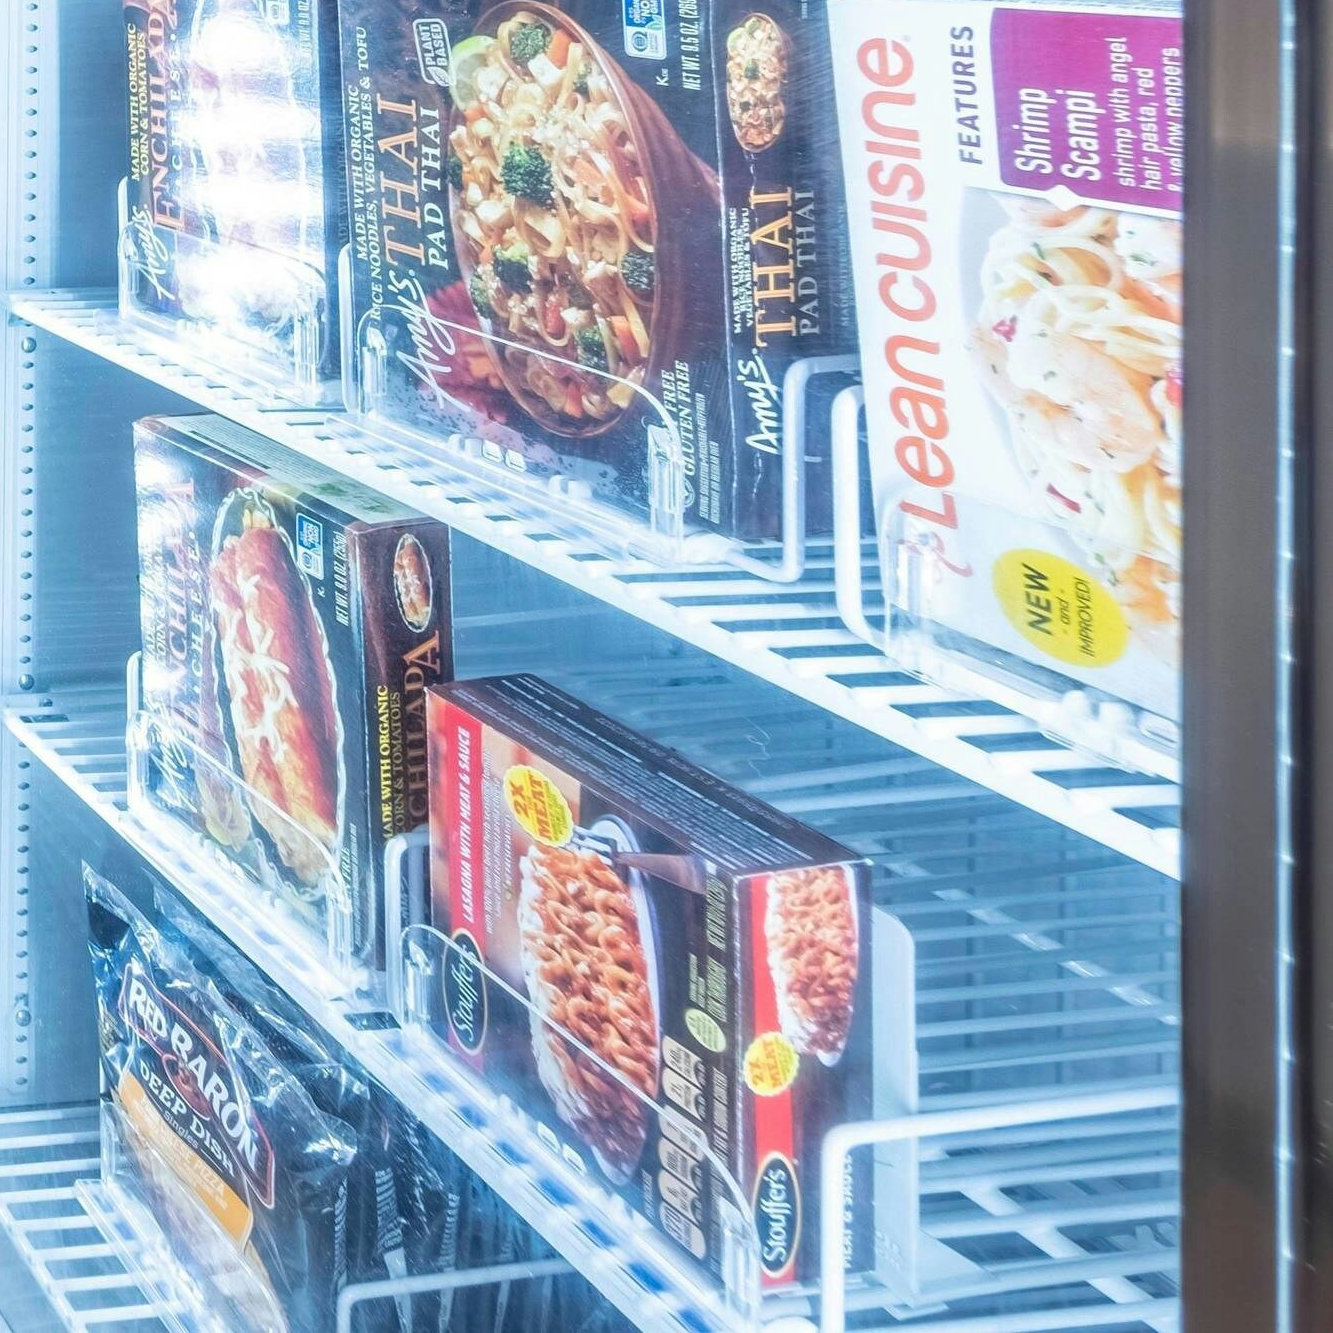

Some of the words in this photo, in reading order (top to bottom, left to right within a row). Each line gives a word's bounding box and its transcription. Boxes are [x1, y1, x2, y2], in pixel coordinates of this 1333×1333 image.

[356, 26, 369, 71] TOFU
[418, 24, 436, 66] PLANT
[430, 23, 448, 67] BASED
[679, 21, 699, 36] OZ.
[127, 22, 138, 91] ORGANIC
[137, 31, 148, 115] TOMATOES
[359, 76, 371, 90] &
[681, 54, 701, 71] WT.
[683, 71, 701, 90] NET
[1104, 37, 1133, 85] angel
[1132, 67, 1155, 98] red
[129, 95, 139, 139] WITH
[950, 25, 984, 165] FEATURES
[1107, 86, 1133, 123] with
[348, 85, 362, 162] ORGANIC
[360, 92, 375, 197] VEGETABLES
[419, 106, 442, 191] THAI
[1013, 87, 1057, 174] Shrimp
[1055, 89, 1107, 182] Scampi
[1135, 102, 1162, 152] pasta,
[130, 143, 141, 182] MADE
[140, 138, 151, 176] CORN
[376, 92, 426, 267] THAI
[1111, 126, 1137, 187] shrimp
[1137, 152, 1163, 191] hair
[352, 165, 366, 209] WITH
[354, 213, 368, 261] MADE
[366, 200, 383, 278] NOODLES,
[423, 202, 449, 271] PAD
[794, 190, 817, 268] THAI
[748, 185, 797, 348] THAI
[798, 276, 820, 336] PAD
[661, 369, 678, 413] FREE
[675, 359, 692, 403] FREE
[678, 408, 696, 476] GLUTEN
[884, 333, 958, 530] Lean
[1021, 562, 1054, 637] NEW
[1055, 595, 1071, 625] and
[1072, 577, 1097, 658] IMPROVED!
[377, 684, 390, 754] ORGANIC
[390, 691, 403, 775] TOMATOES
[457, 726, 471, 770] SAUCE
[380, 758, 392, 797] WITH
[459, 785, 471, 818] MEAT
[510, 777, 530, 819] 2X
[529, 772, 553, 840] MEAT
[460, 821, 472, 856] WITH
[460, 858, 475, 924] LASAGNA
[129, 977, 169, 1039] RED
[139, 1060, 187, 1116] DEEP
[191, 1116, 235, 1177] DISH
[163, 1110, 199, 1149] Singles
[761, 1167, 792, 1261] Stouffer's
